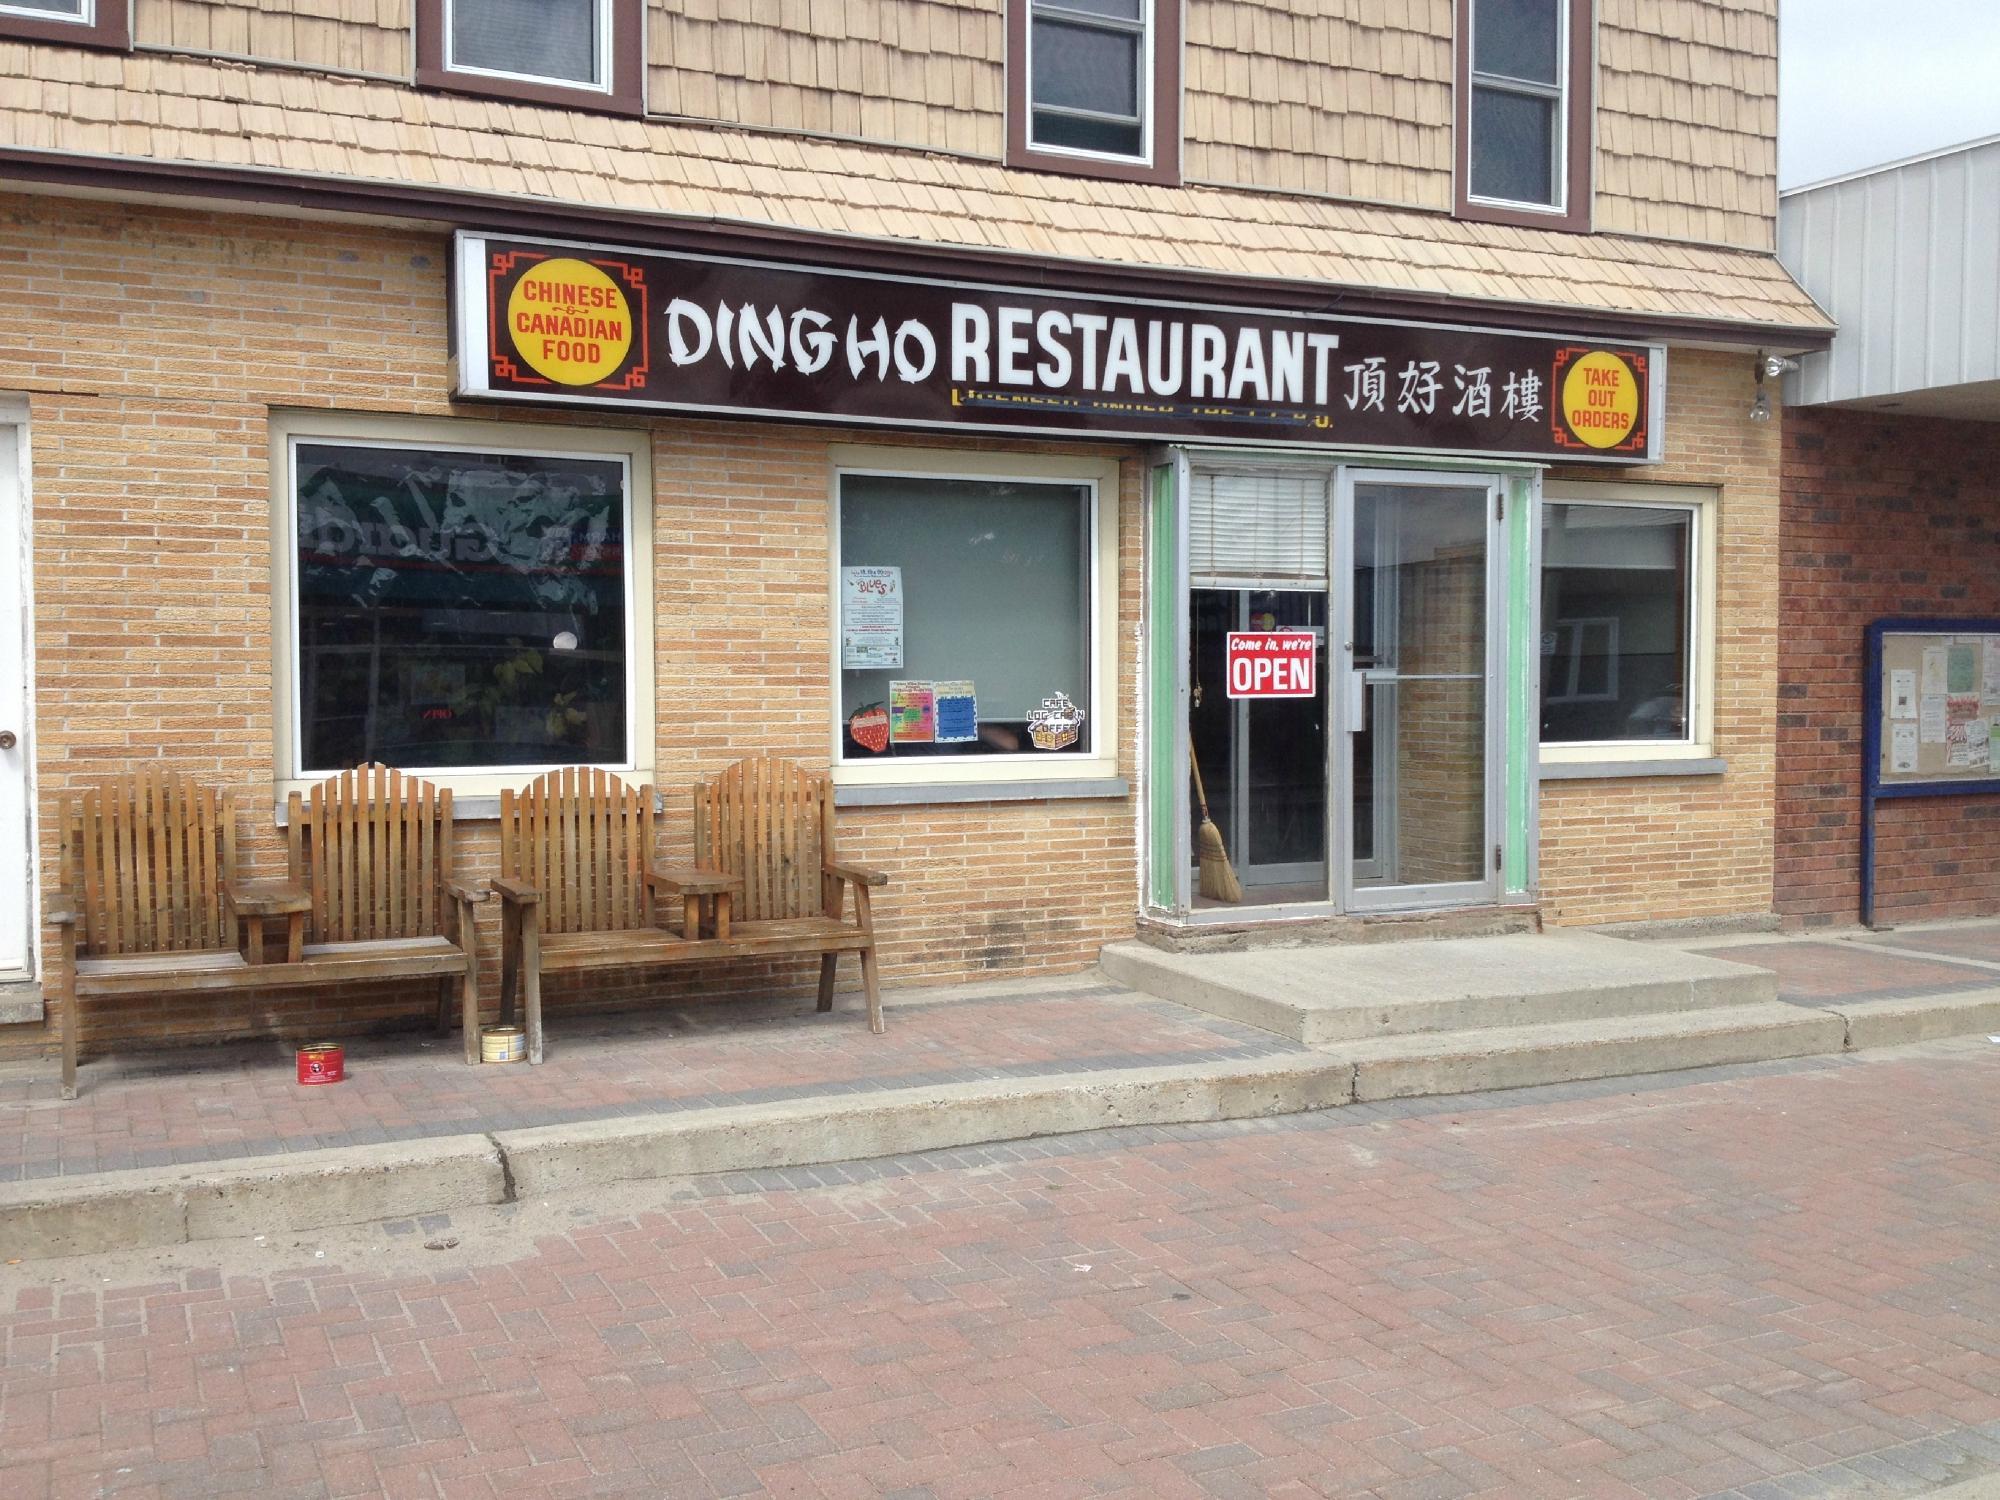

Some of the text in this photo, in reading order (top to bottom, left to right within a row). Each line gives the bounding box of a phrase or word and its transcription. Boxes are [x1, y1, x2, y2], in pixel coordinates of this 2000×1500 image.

[523, 280, 618, 309] CHINESE
[516, 312, 623, 342] CANADIAN
[542, 339, 601, 364] FOOD
[663, 296, 1339, 405] DING HO RESTAURANT
[1343, 356, 1543, 422] 頂好酒樓
[1583, 367, 1620, 388] TAKE
[1588, 389, 1616, 408] OUT
[1571, 409, 1629, 430] ORDERS
[1231, 637, 1312, 652] Come in, we're
[1232, 657, 1310, 692] OPEN
